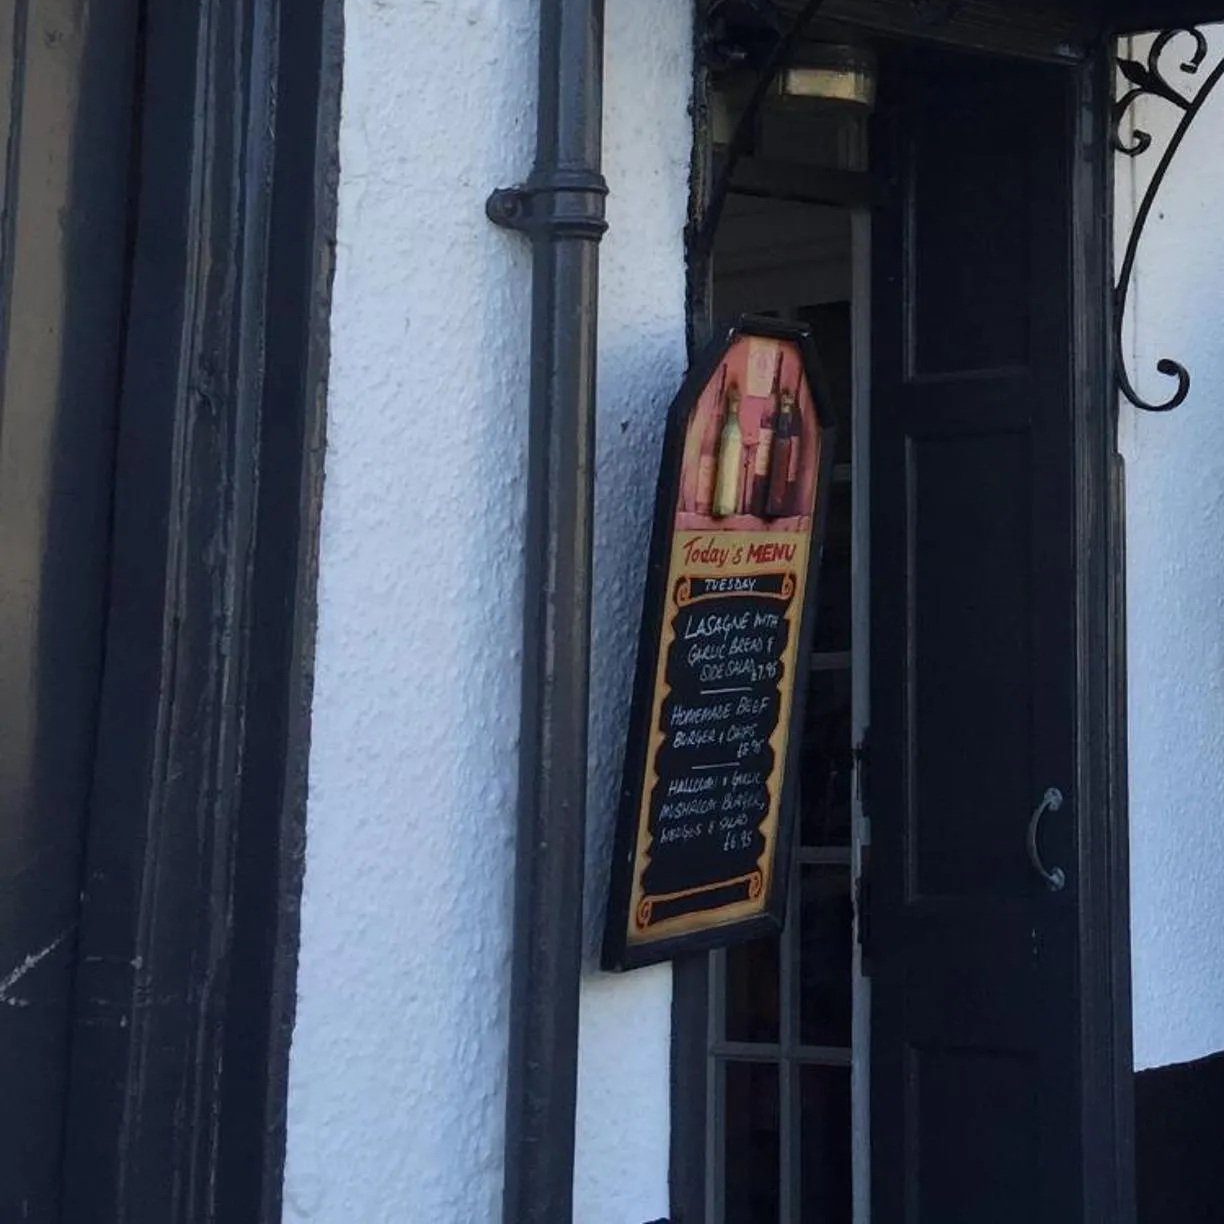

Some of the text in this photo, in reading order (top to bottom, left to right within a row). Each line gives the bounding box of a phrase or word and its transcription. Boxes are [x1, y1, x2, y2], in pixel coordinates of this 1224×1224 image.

[682, 536, 797, 567] Today's MENU
[704, 577, 757, 592] TUESDAY
[684, 612, 751, 641] LASAGNE
